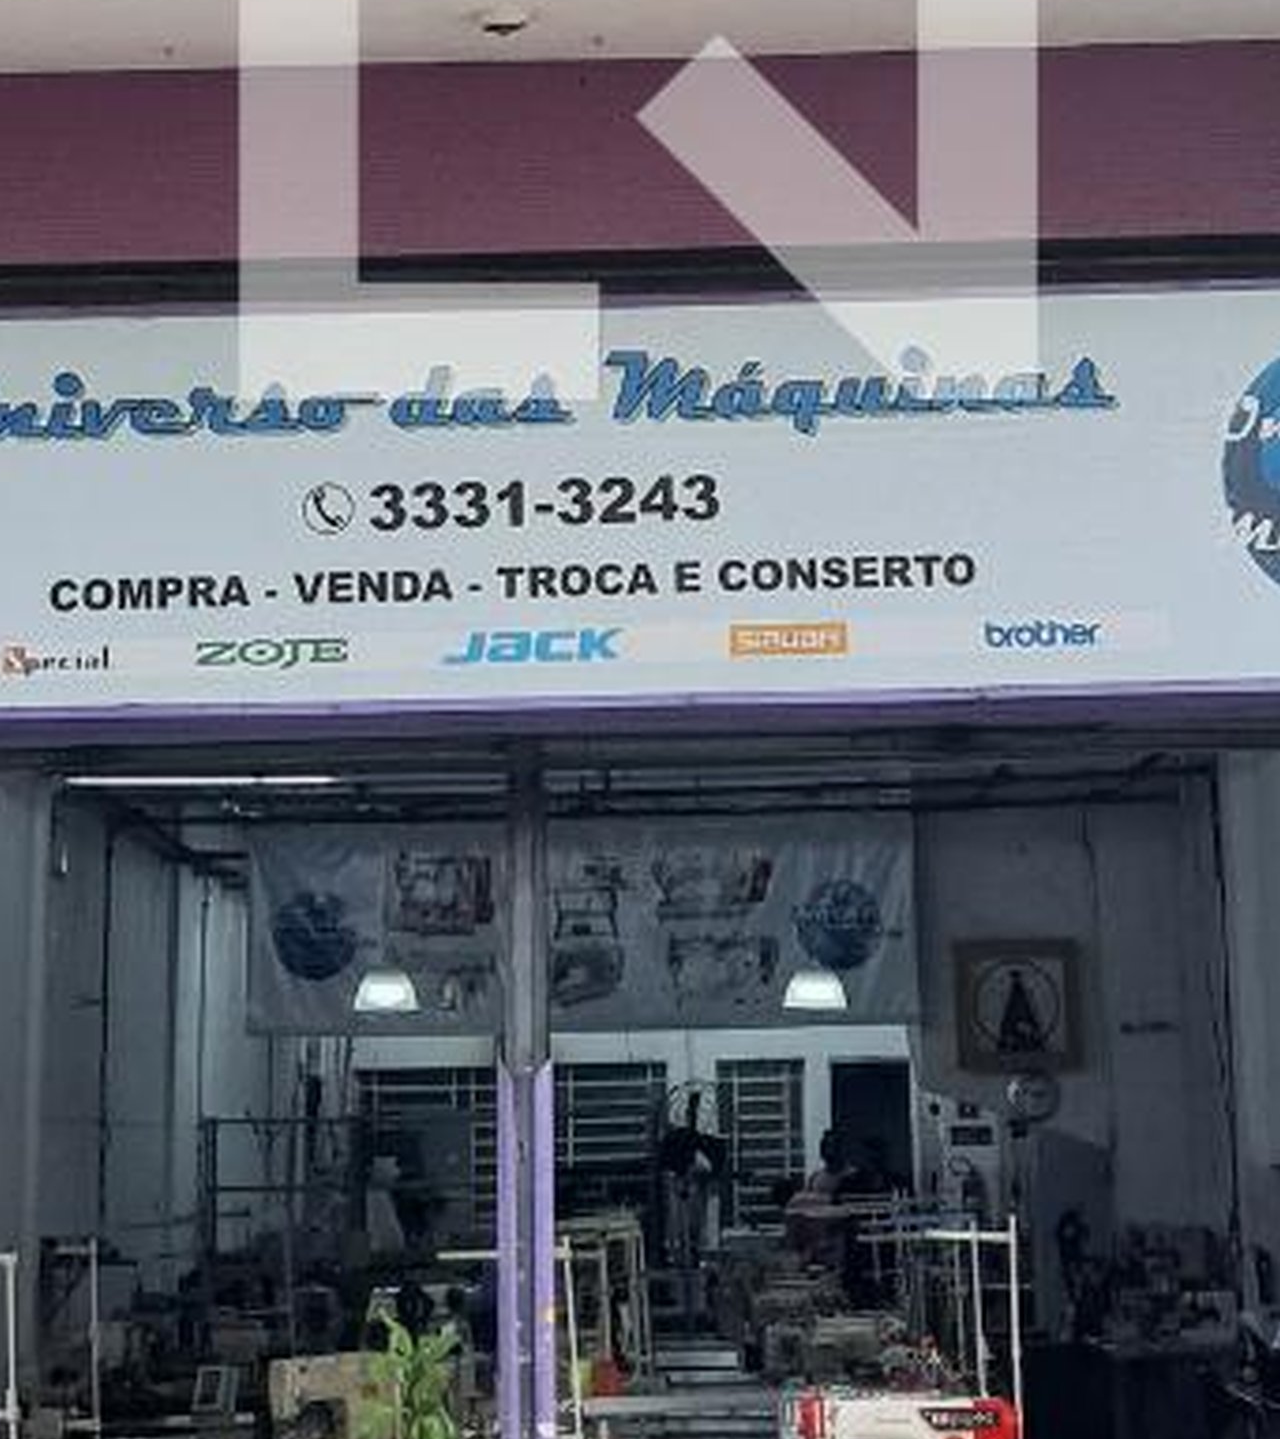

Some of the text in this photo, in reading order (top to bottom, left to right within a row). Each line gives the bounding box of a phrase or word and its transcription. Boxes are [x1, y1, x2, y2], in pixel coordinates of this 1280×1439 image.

[388, 364, 577, 431] das
[604, 345, 1119, 436] Máquinas
[368, 474, 720, 531] 3331-3243
[49, 575, 250, 611] COMPRA
[294, 568, 453, 604] VENDA
[497, 562, 658, 599] TROCA
[675, 561, 702, 592] E
[718, 553, 976, 592] CONSERTO
[195, 637, 349, 669] ZOJE
[984, 621, 1102, 649] brother
